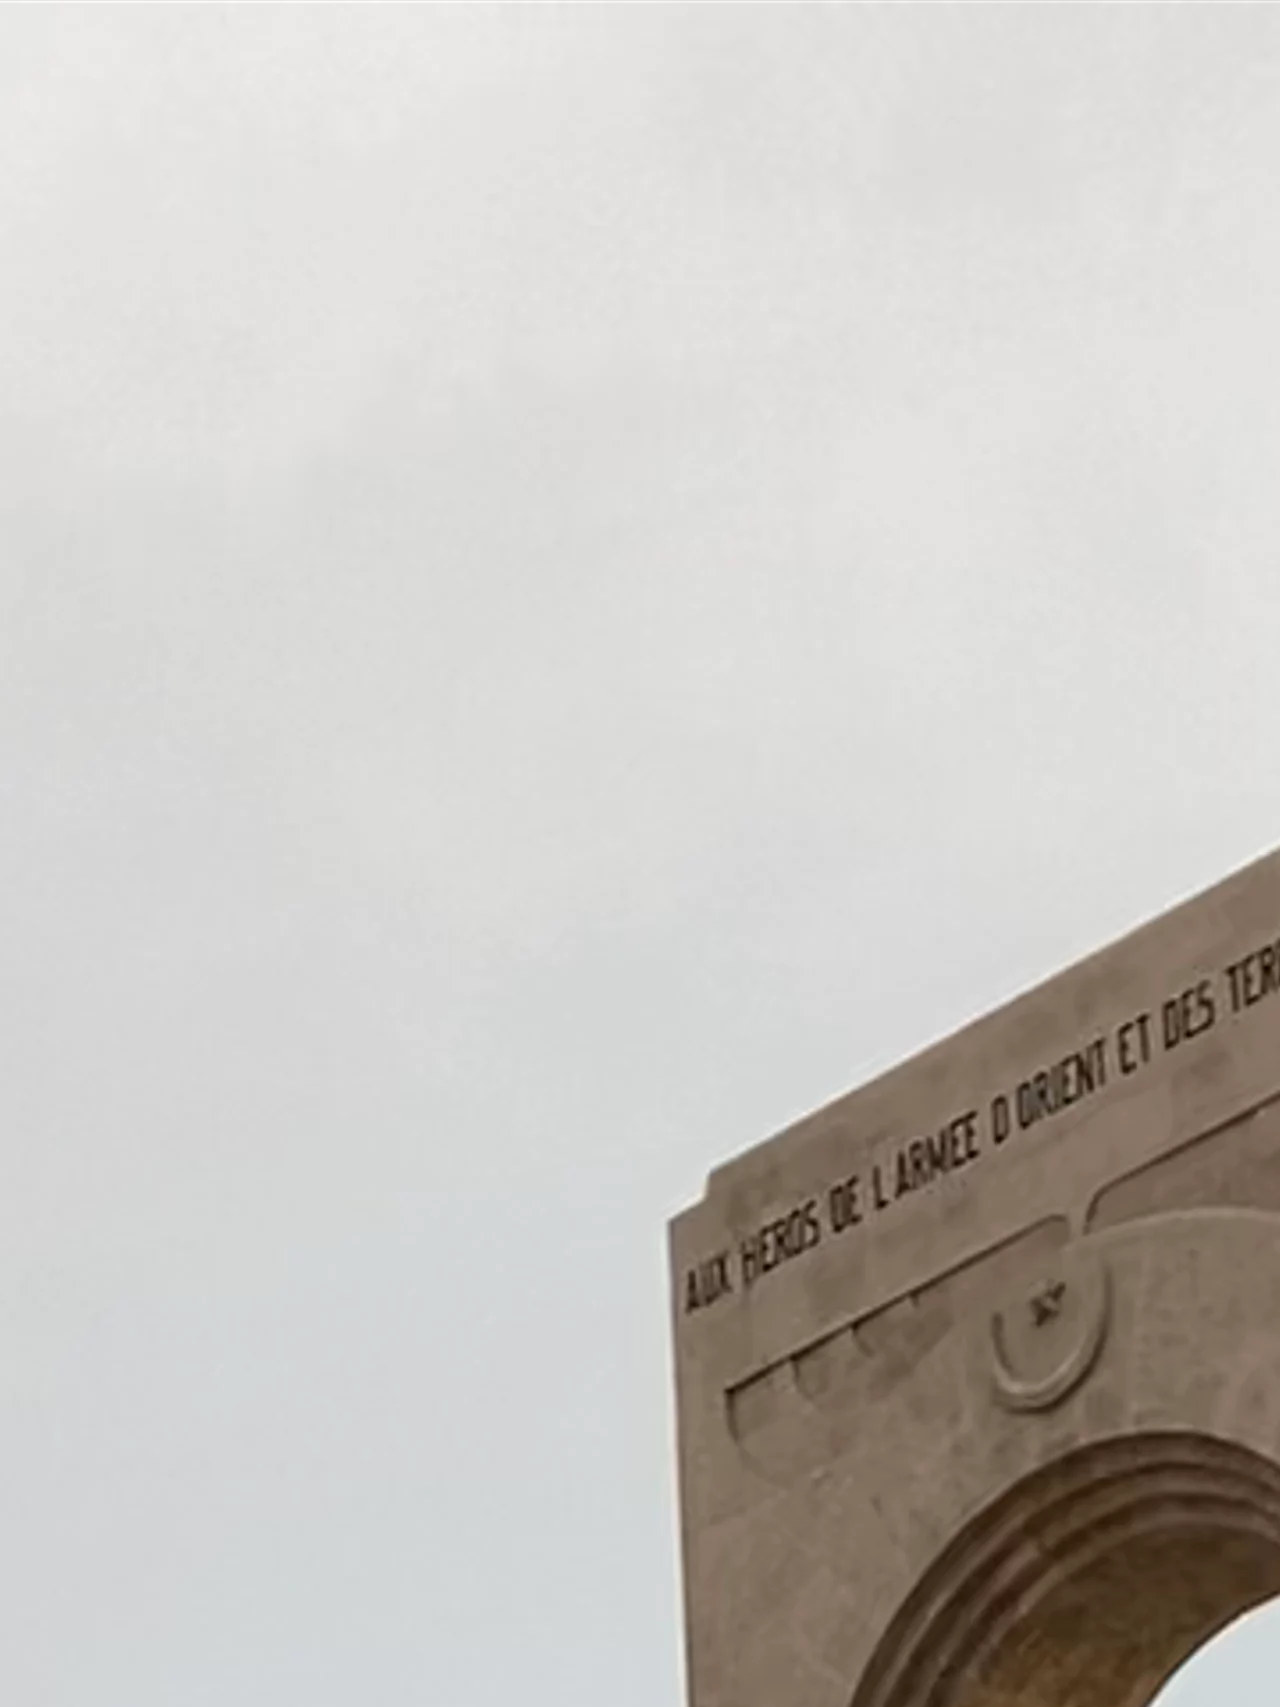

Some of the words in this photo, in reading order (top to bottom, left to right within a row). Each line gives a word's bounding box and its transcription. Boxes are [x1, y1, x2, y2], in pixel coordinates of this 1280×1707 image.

[685, 1250, 733, 1314] AUX
[740, 1199, 821, 1287] HEROS
[828, 1175, 863, 1234] DE
[1117, 1012, 1151, 1075] ET
[1161, 979, 1217, 1051] DES
